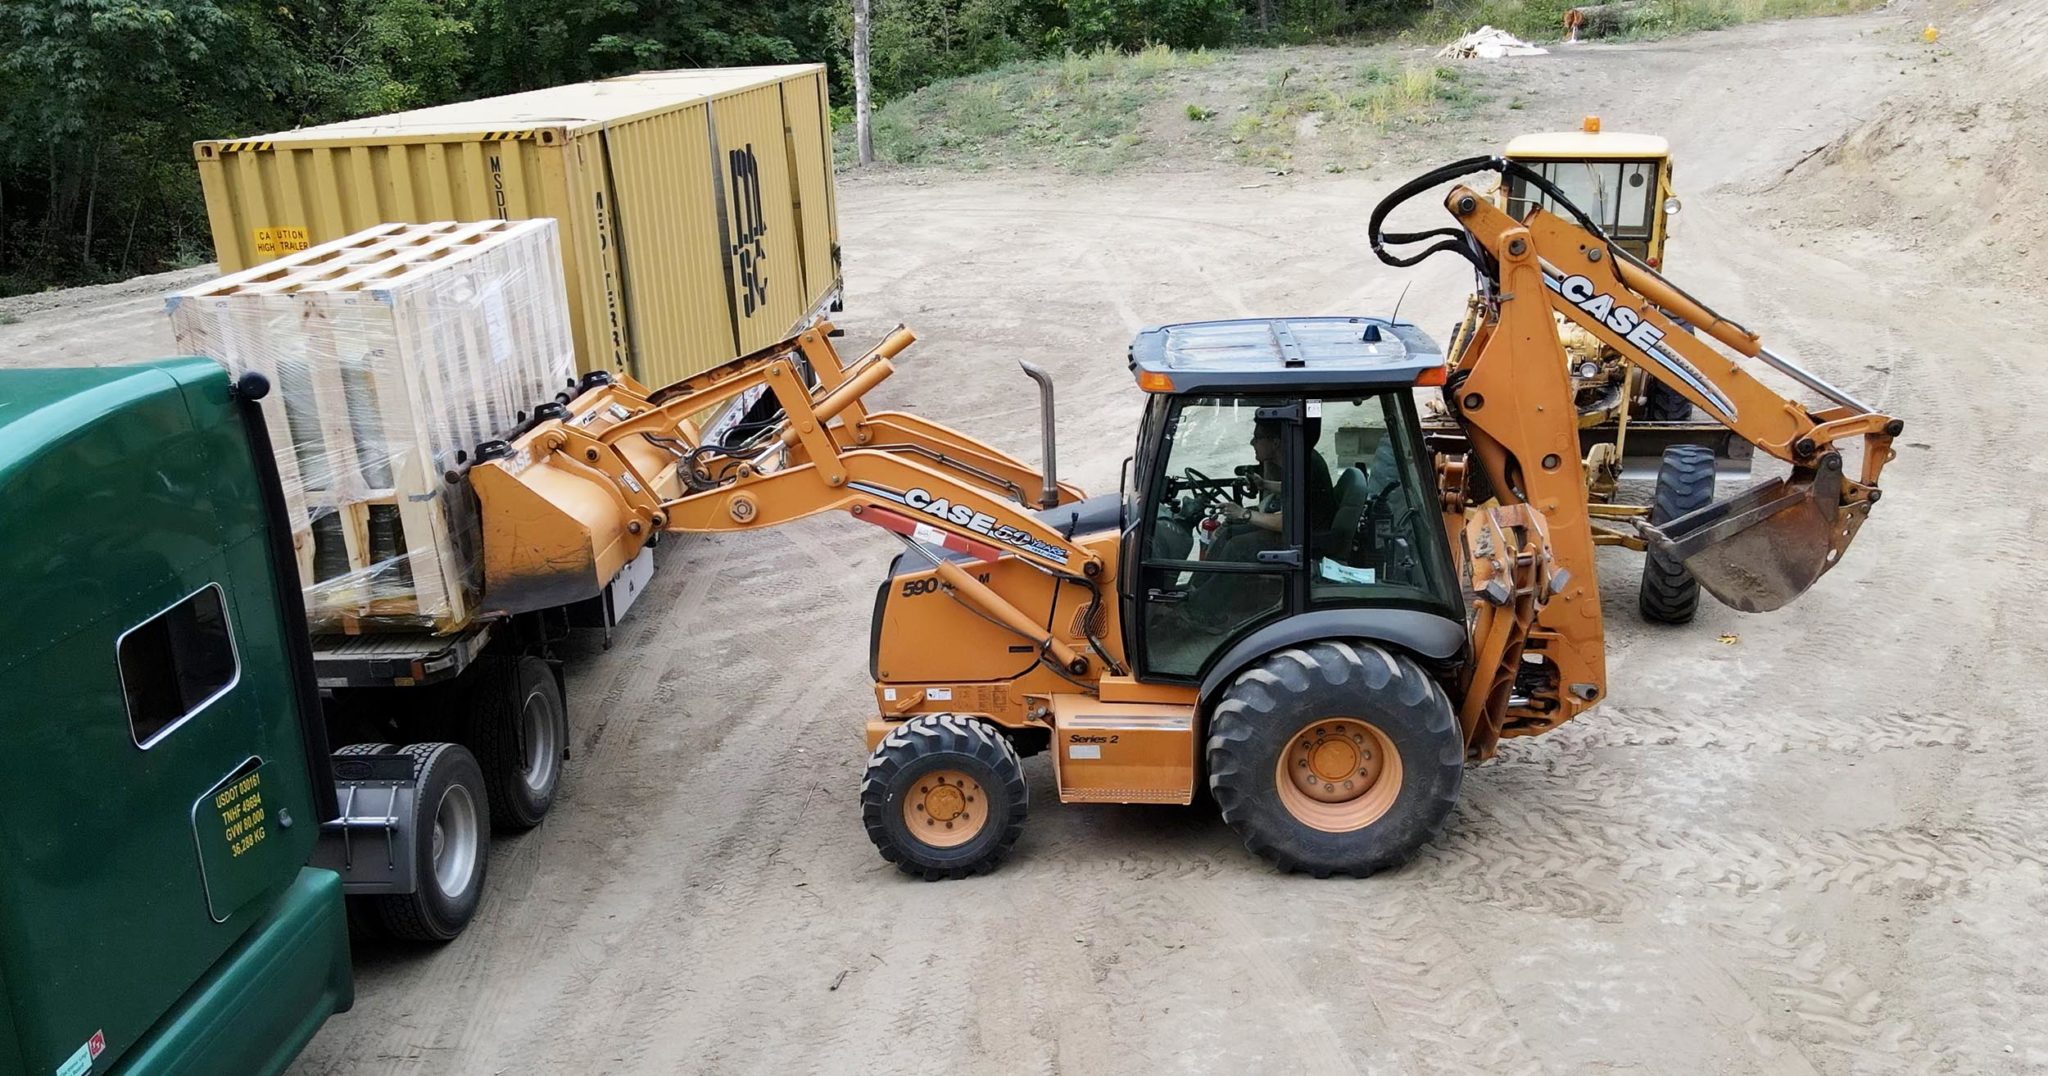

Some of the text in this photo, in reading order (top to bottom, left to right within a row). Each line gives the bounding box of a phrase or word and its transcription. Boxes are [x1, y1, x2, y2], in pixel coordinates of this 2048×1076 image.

[259, 230, 304, 240] CAUTION
[257, 241, 309, 252] HIGH TRAILER
[1560, 274, 1667, 352] CASE
[904, 488, 999, 536] CASE
[993, 525, 1033, 545] 50
[902, 577, 938, 597] 590
[1069, 734, 1119, 744] Series 2
[215, 785, 239, 809] USDOT
[225, 821, 243, 841] GVW
[253, 826, 266, 842] KG
